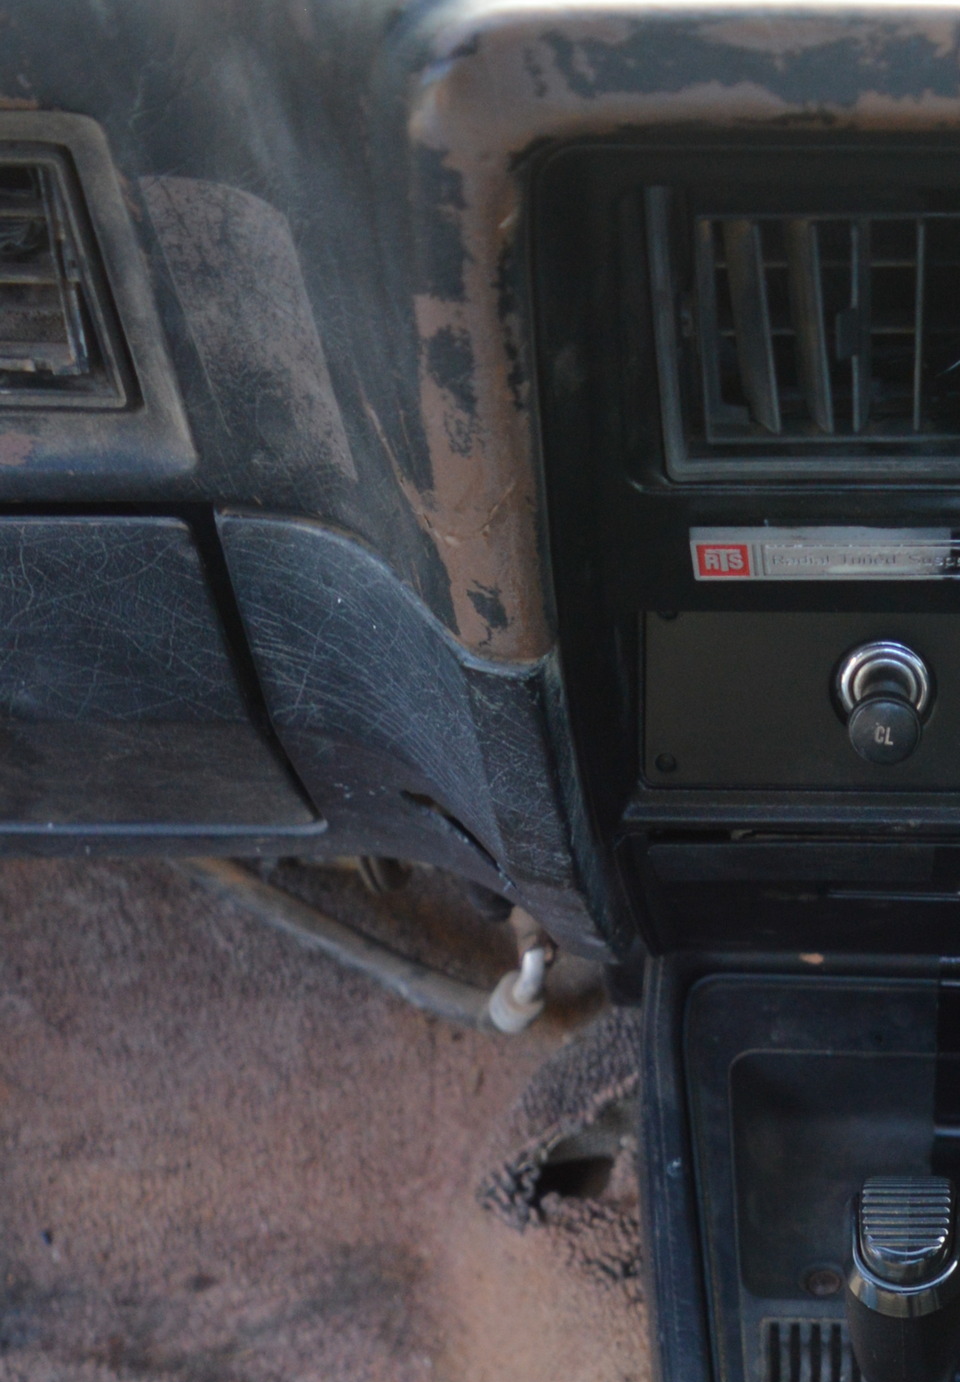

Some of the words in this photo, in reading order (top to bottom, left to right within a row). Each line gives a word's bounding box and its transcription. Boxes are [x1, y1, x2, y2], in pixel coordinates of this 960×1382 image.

[704, 548, 745, 572] RTS
[772, 553, 830, 567] Radial
[874, 725, 894, 746] CL
